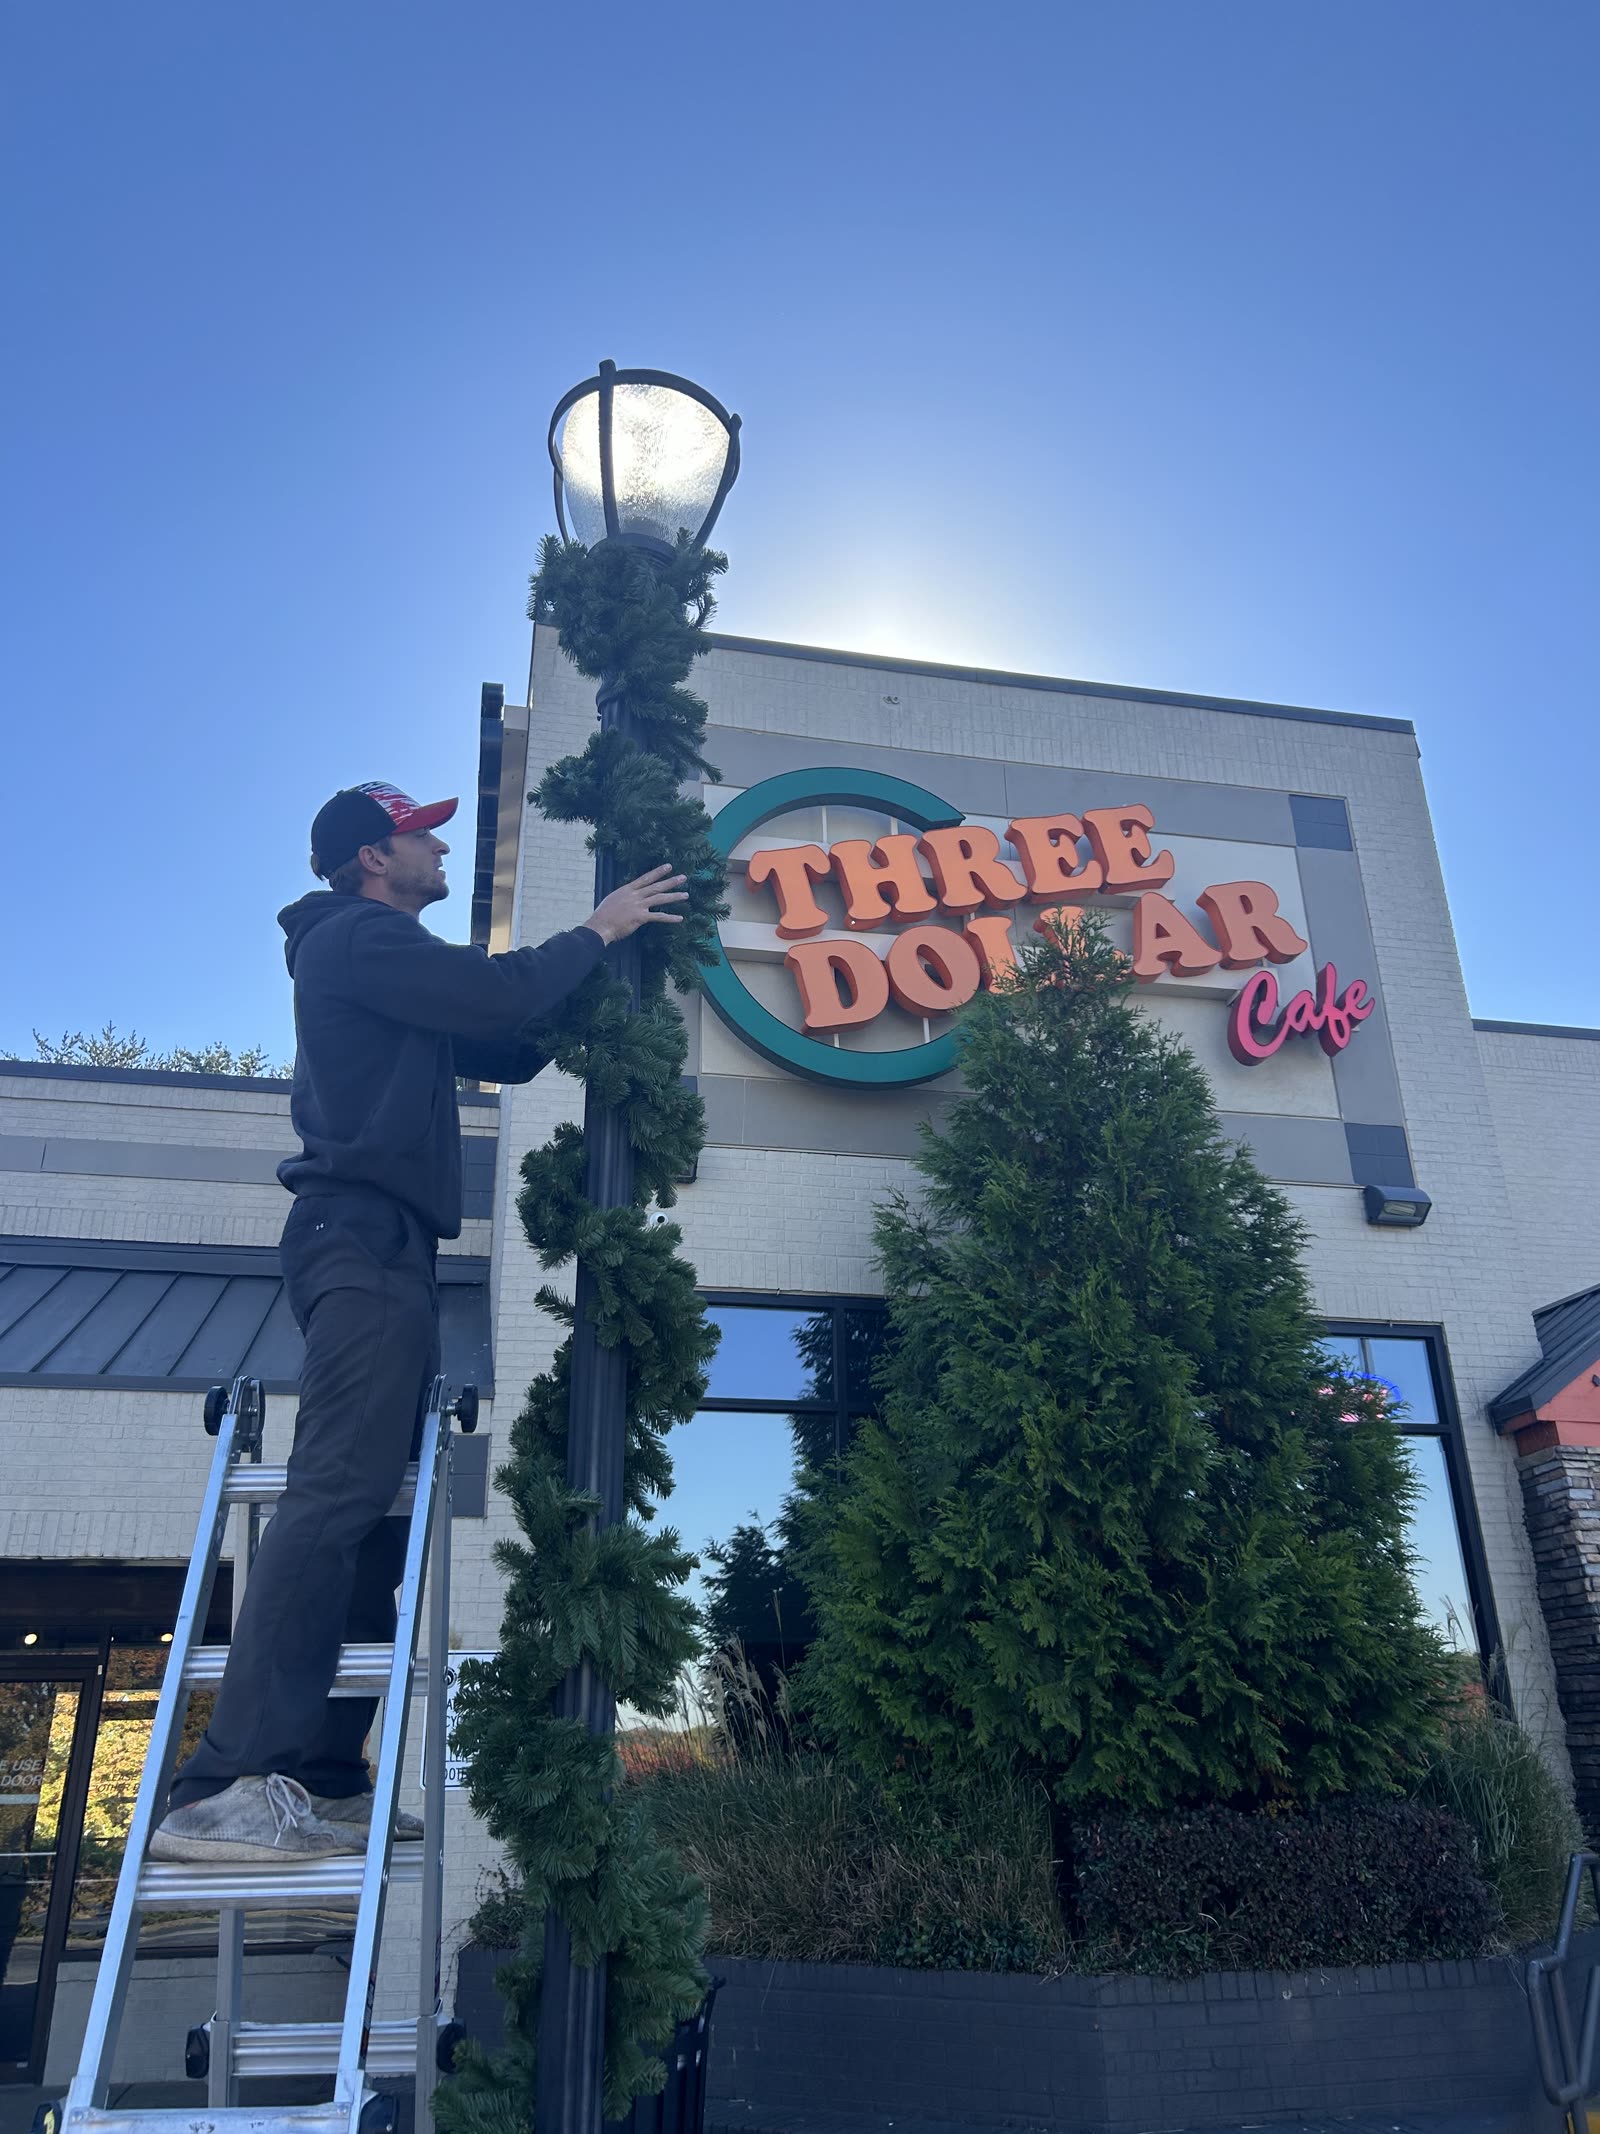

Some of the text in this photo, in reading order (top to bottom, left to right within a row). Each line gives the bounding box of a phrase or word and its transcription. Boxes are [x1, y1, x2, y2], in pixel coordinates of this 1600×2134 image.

[746, 804, 1175, 940] THREE
[1228, 961, 1376, 1066] Cafe
[0, 1774, 42, 1786] DOOR
[12, 1759, 43, 1771] USE
